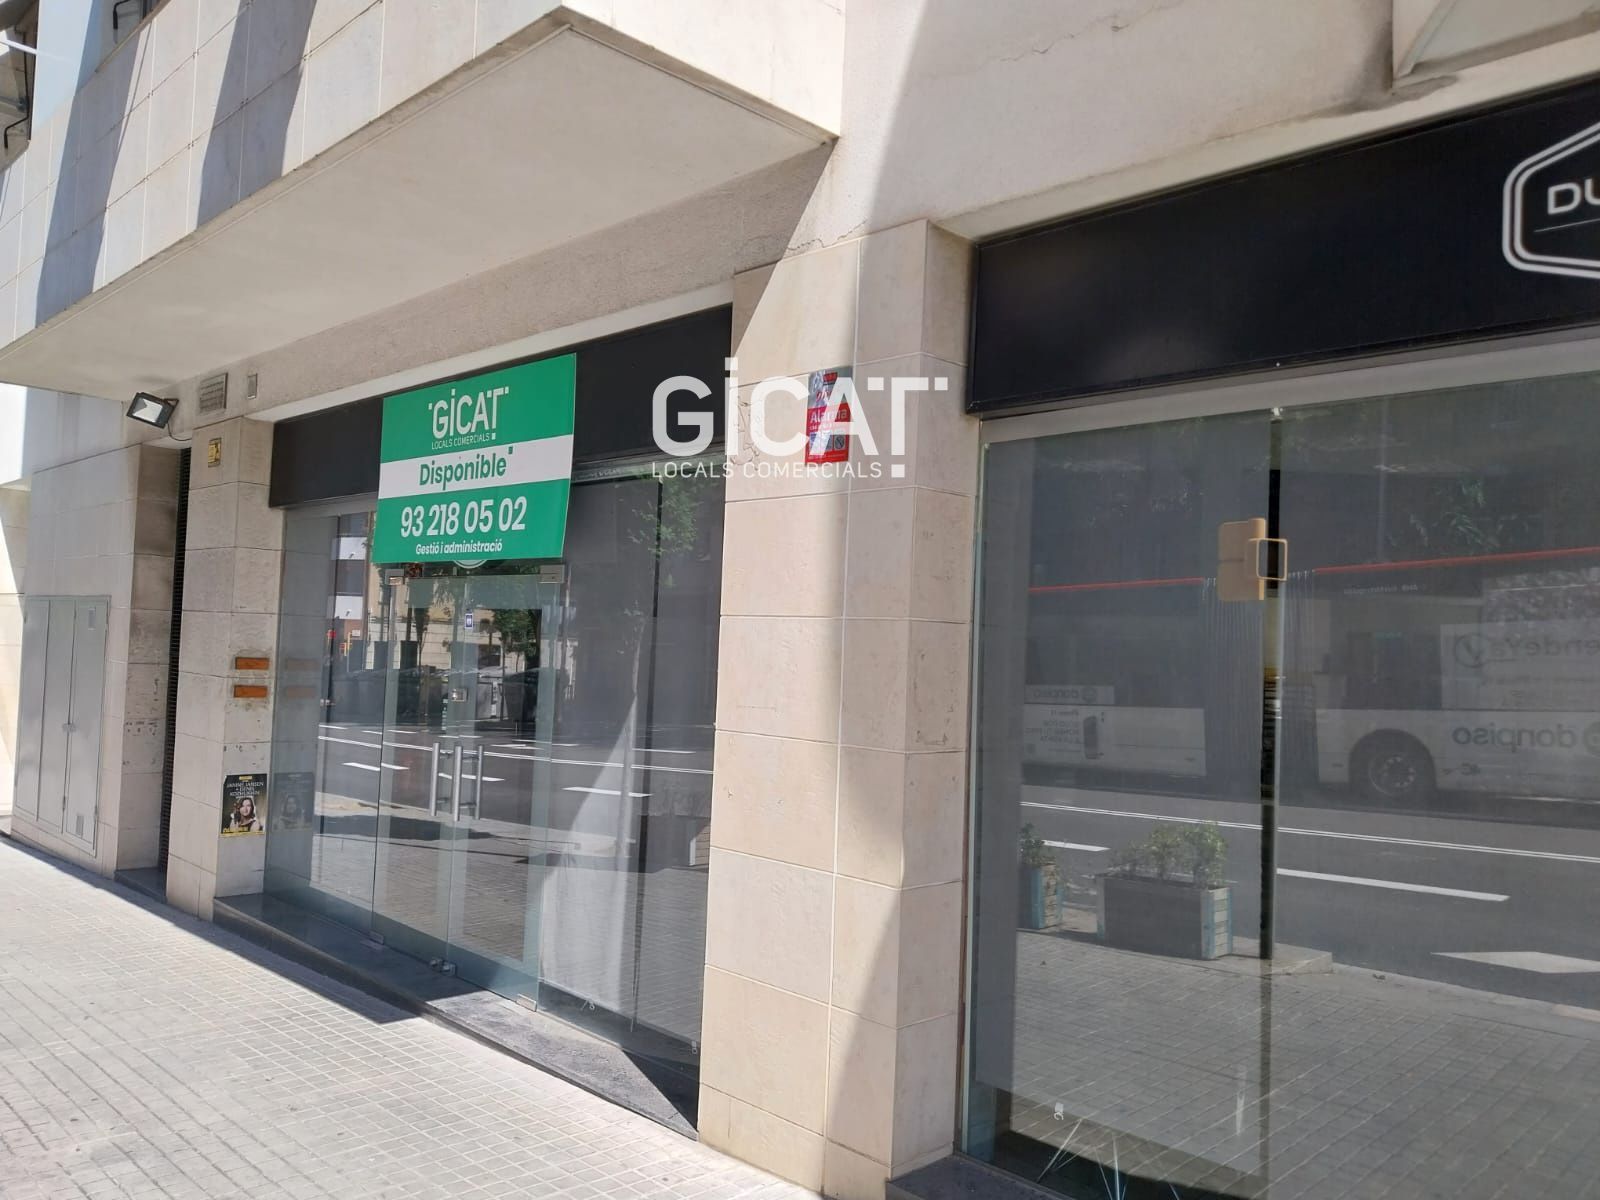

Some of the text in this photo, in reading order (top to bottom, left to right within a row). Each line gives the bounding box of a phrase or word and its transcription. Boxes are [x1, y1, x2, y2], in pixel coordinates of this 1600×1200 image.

[431, 432, 490, 450] LOCALS COMERCIALS
[419, 452, 507, 491] Disponible
[400, 496, 528, 538] 93 218 05 02
[415, 541, 440, 555] Gestió
[443, 538, 503, 554] administració
